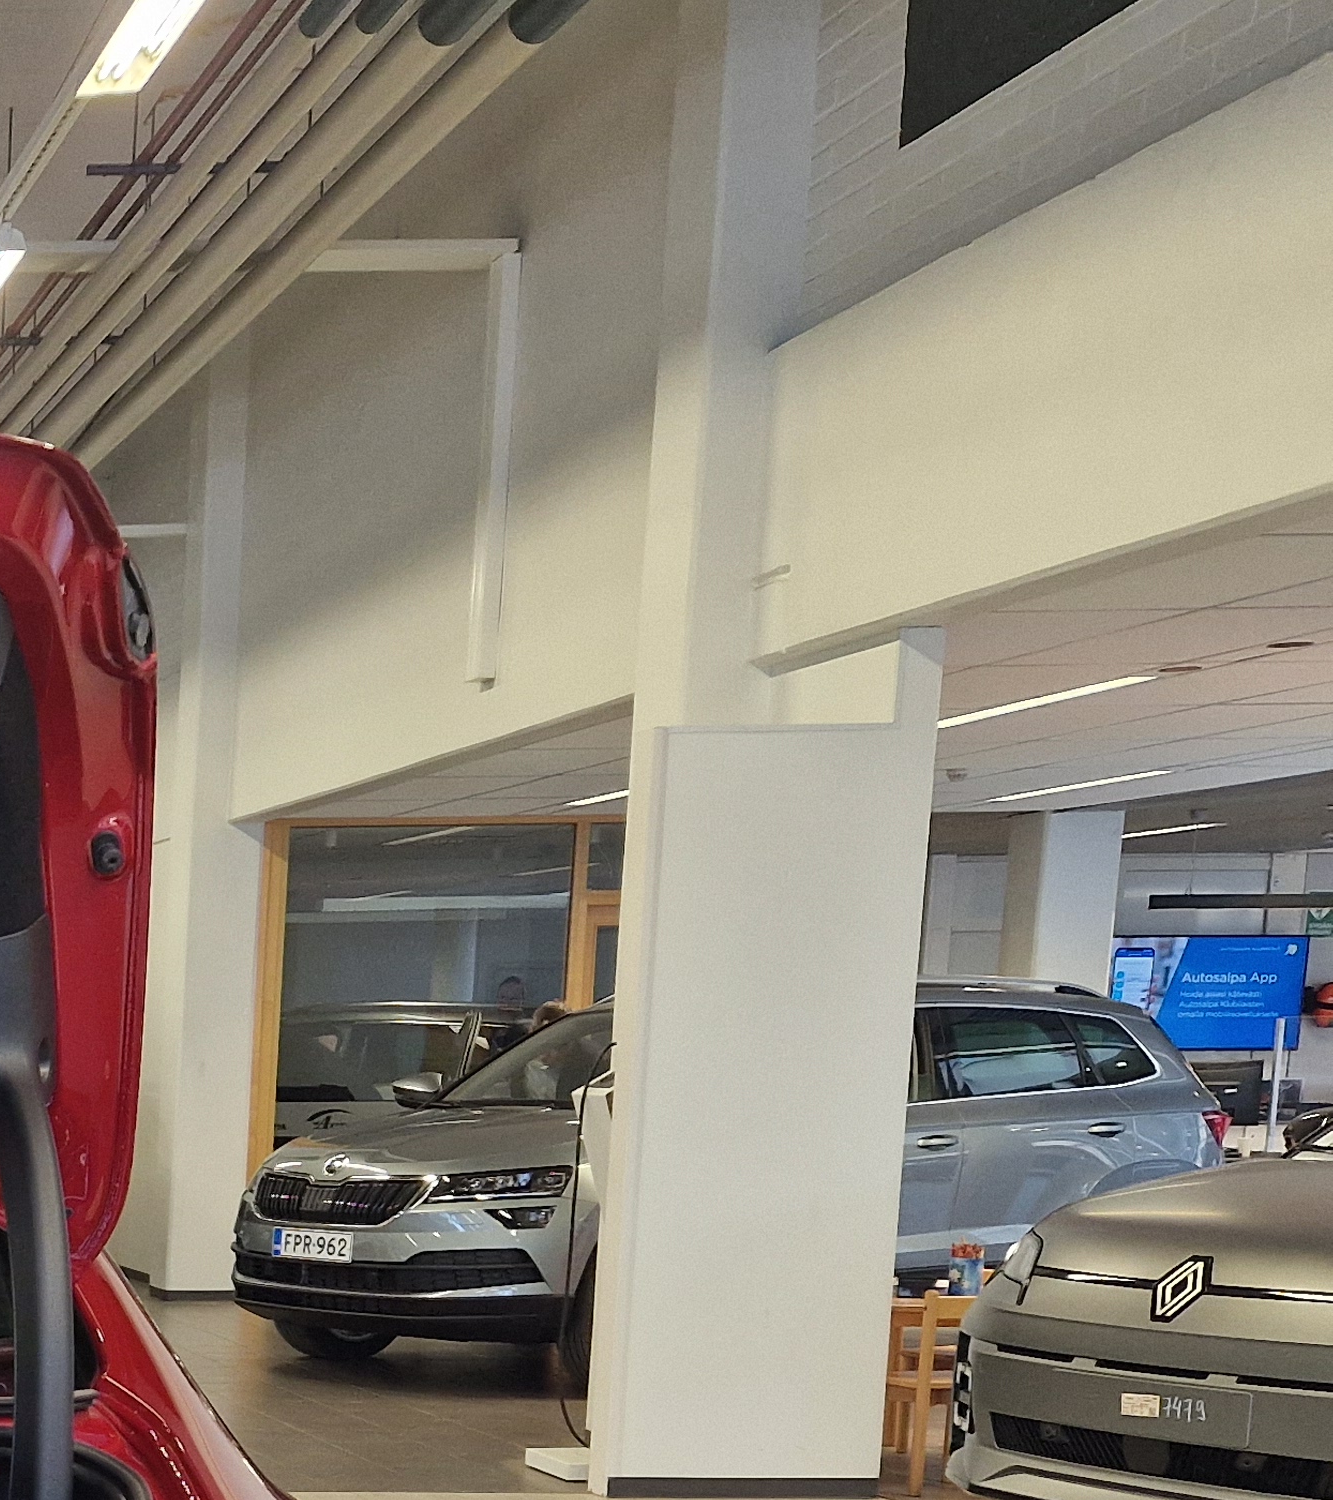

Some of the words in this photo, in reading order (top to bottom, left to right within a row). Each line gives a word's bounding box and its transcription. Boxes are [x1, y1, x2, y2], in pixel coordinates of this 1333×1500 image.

[1181, 971, 1247, 984] Autosalpa
[1249, 971, 1278, 984] App
[284, 1233, 347, 1257] FPR-962
